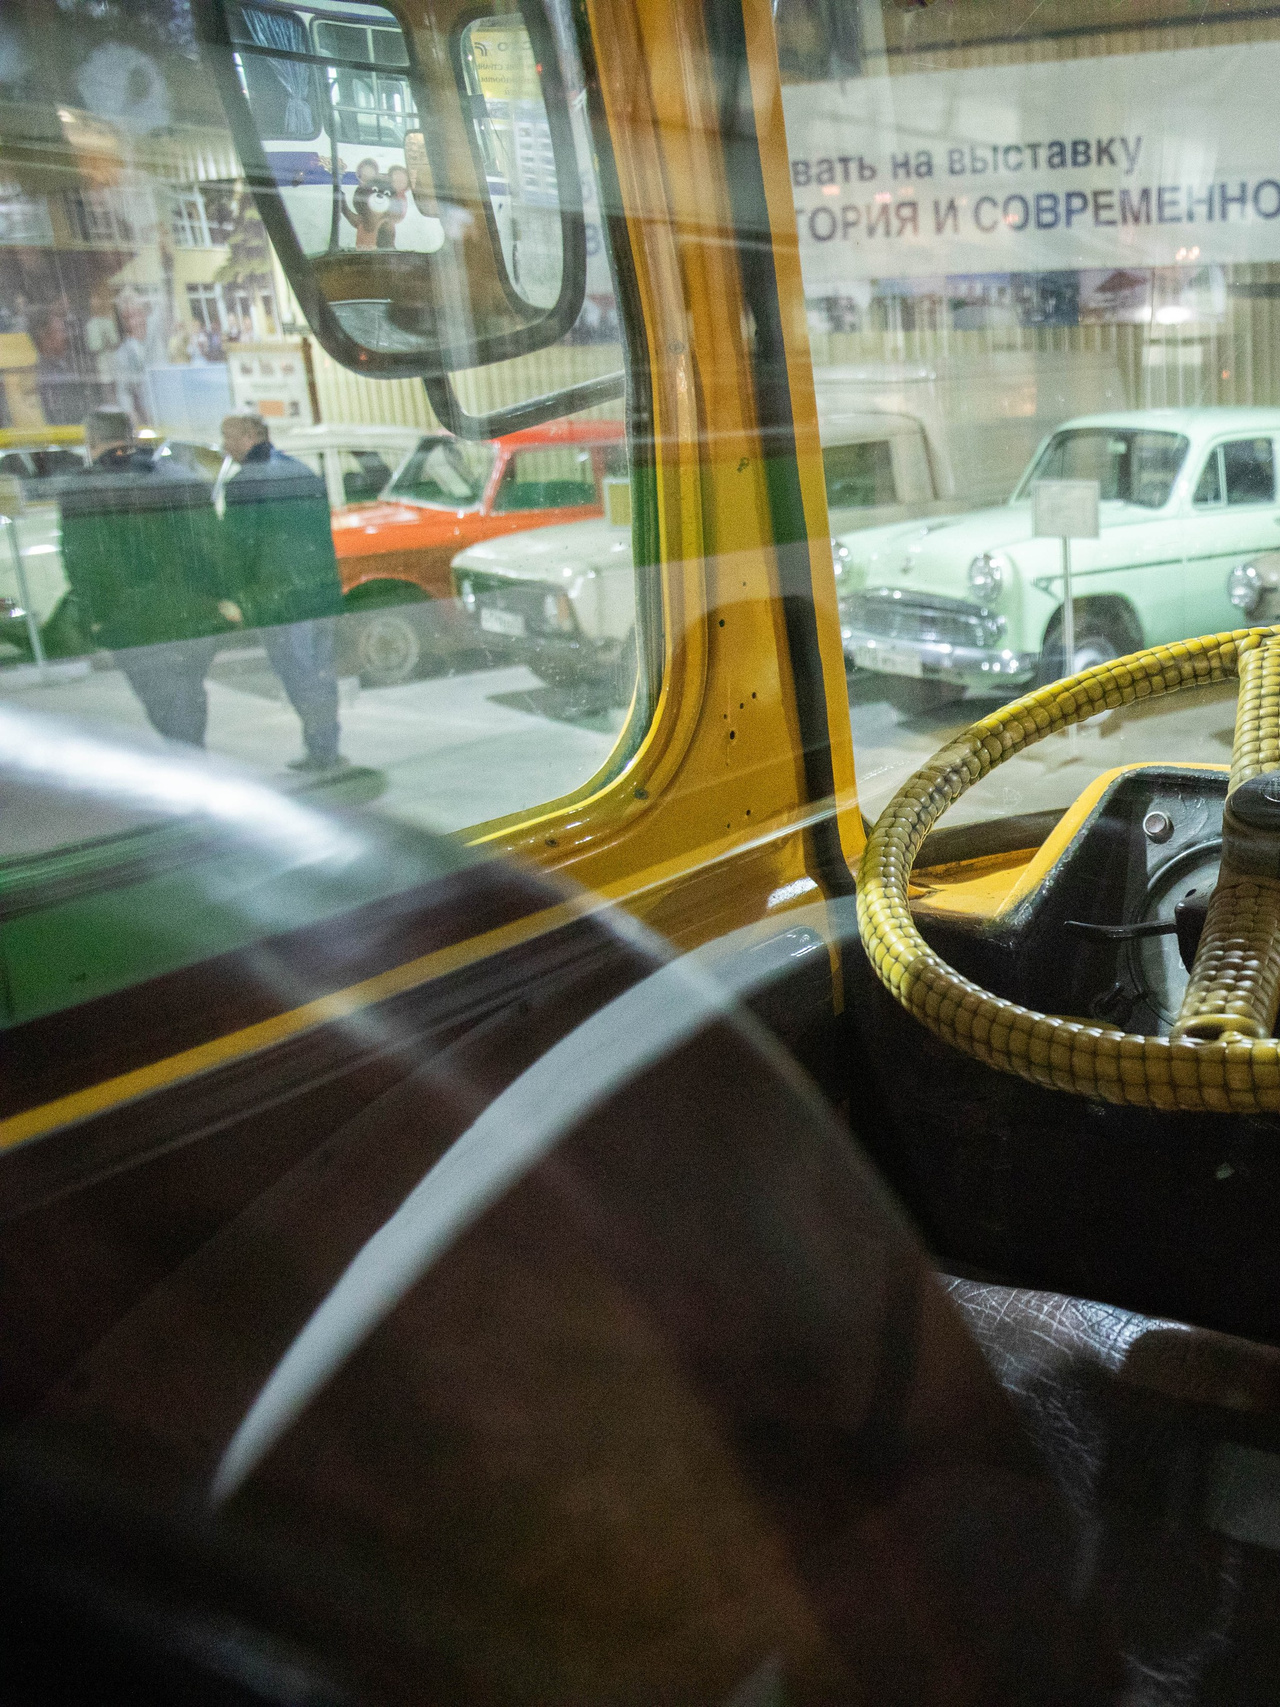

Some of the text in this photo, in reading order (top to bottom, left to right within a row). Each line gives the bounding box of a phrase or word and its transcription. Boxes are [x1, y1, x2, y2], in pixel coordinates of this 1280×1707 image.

[890, 150, 933, 179] на
[948, 135, 1142, 176] выставку
[796, 200, 918, 242] ОРИЯ
[933, 197, 960, 235] И
